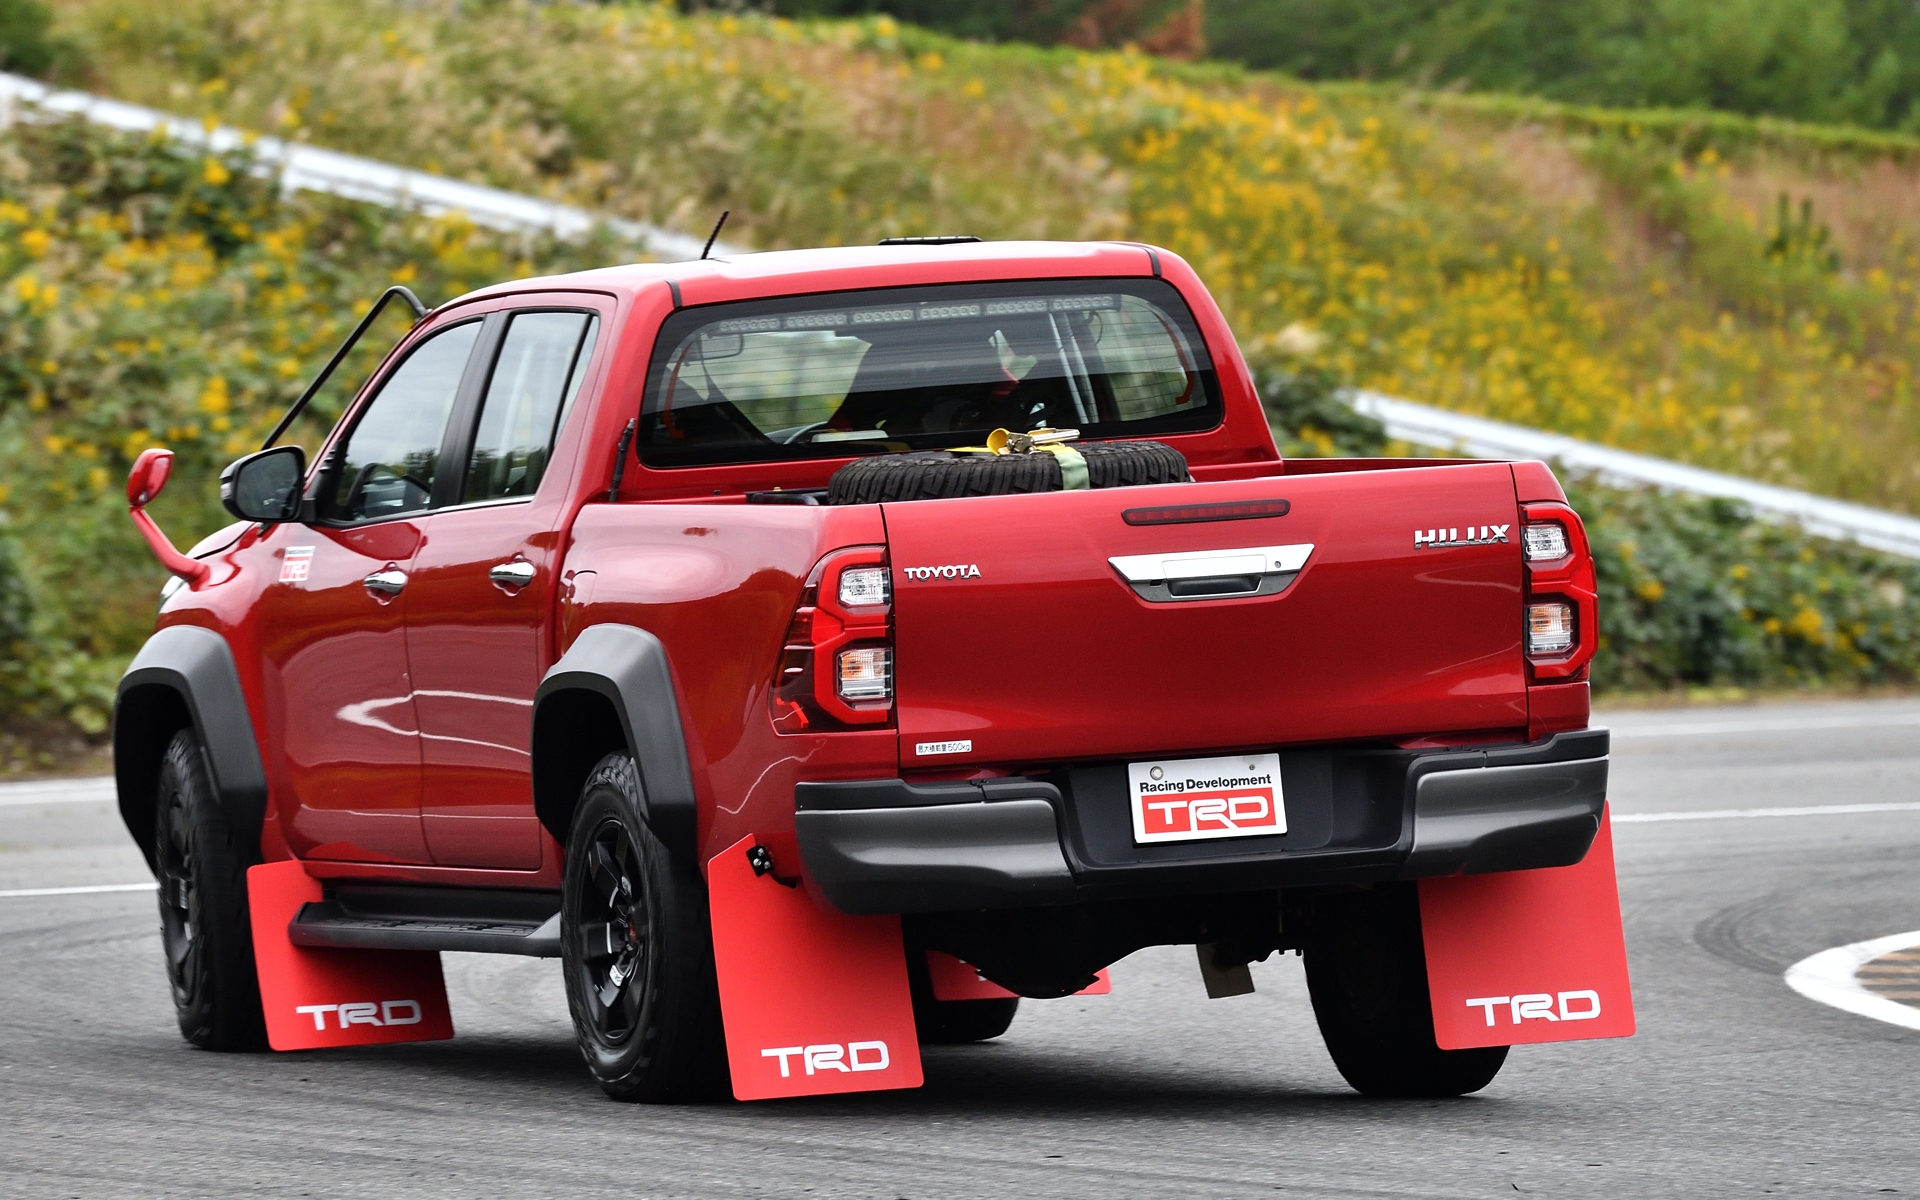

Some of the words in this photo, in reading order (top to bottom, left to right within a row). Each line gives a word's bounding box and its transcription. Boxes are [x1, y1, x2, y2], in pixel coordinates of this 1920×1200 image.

[1414, 524, 1510, 549] HILUX
[904, 564, 981, 581] TOYOTA
[1139, 780, 1184, 793] Racing
[1186, 774, 1272, 790] Development
[1148, 795, 1269, 831] TRD
[296, 1000, 422, 1031] TRD
[1466, 989, 1601, 1027] TRD
[761, 1040, 890, 1078] TRD
